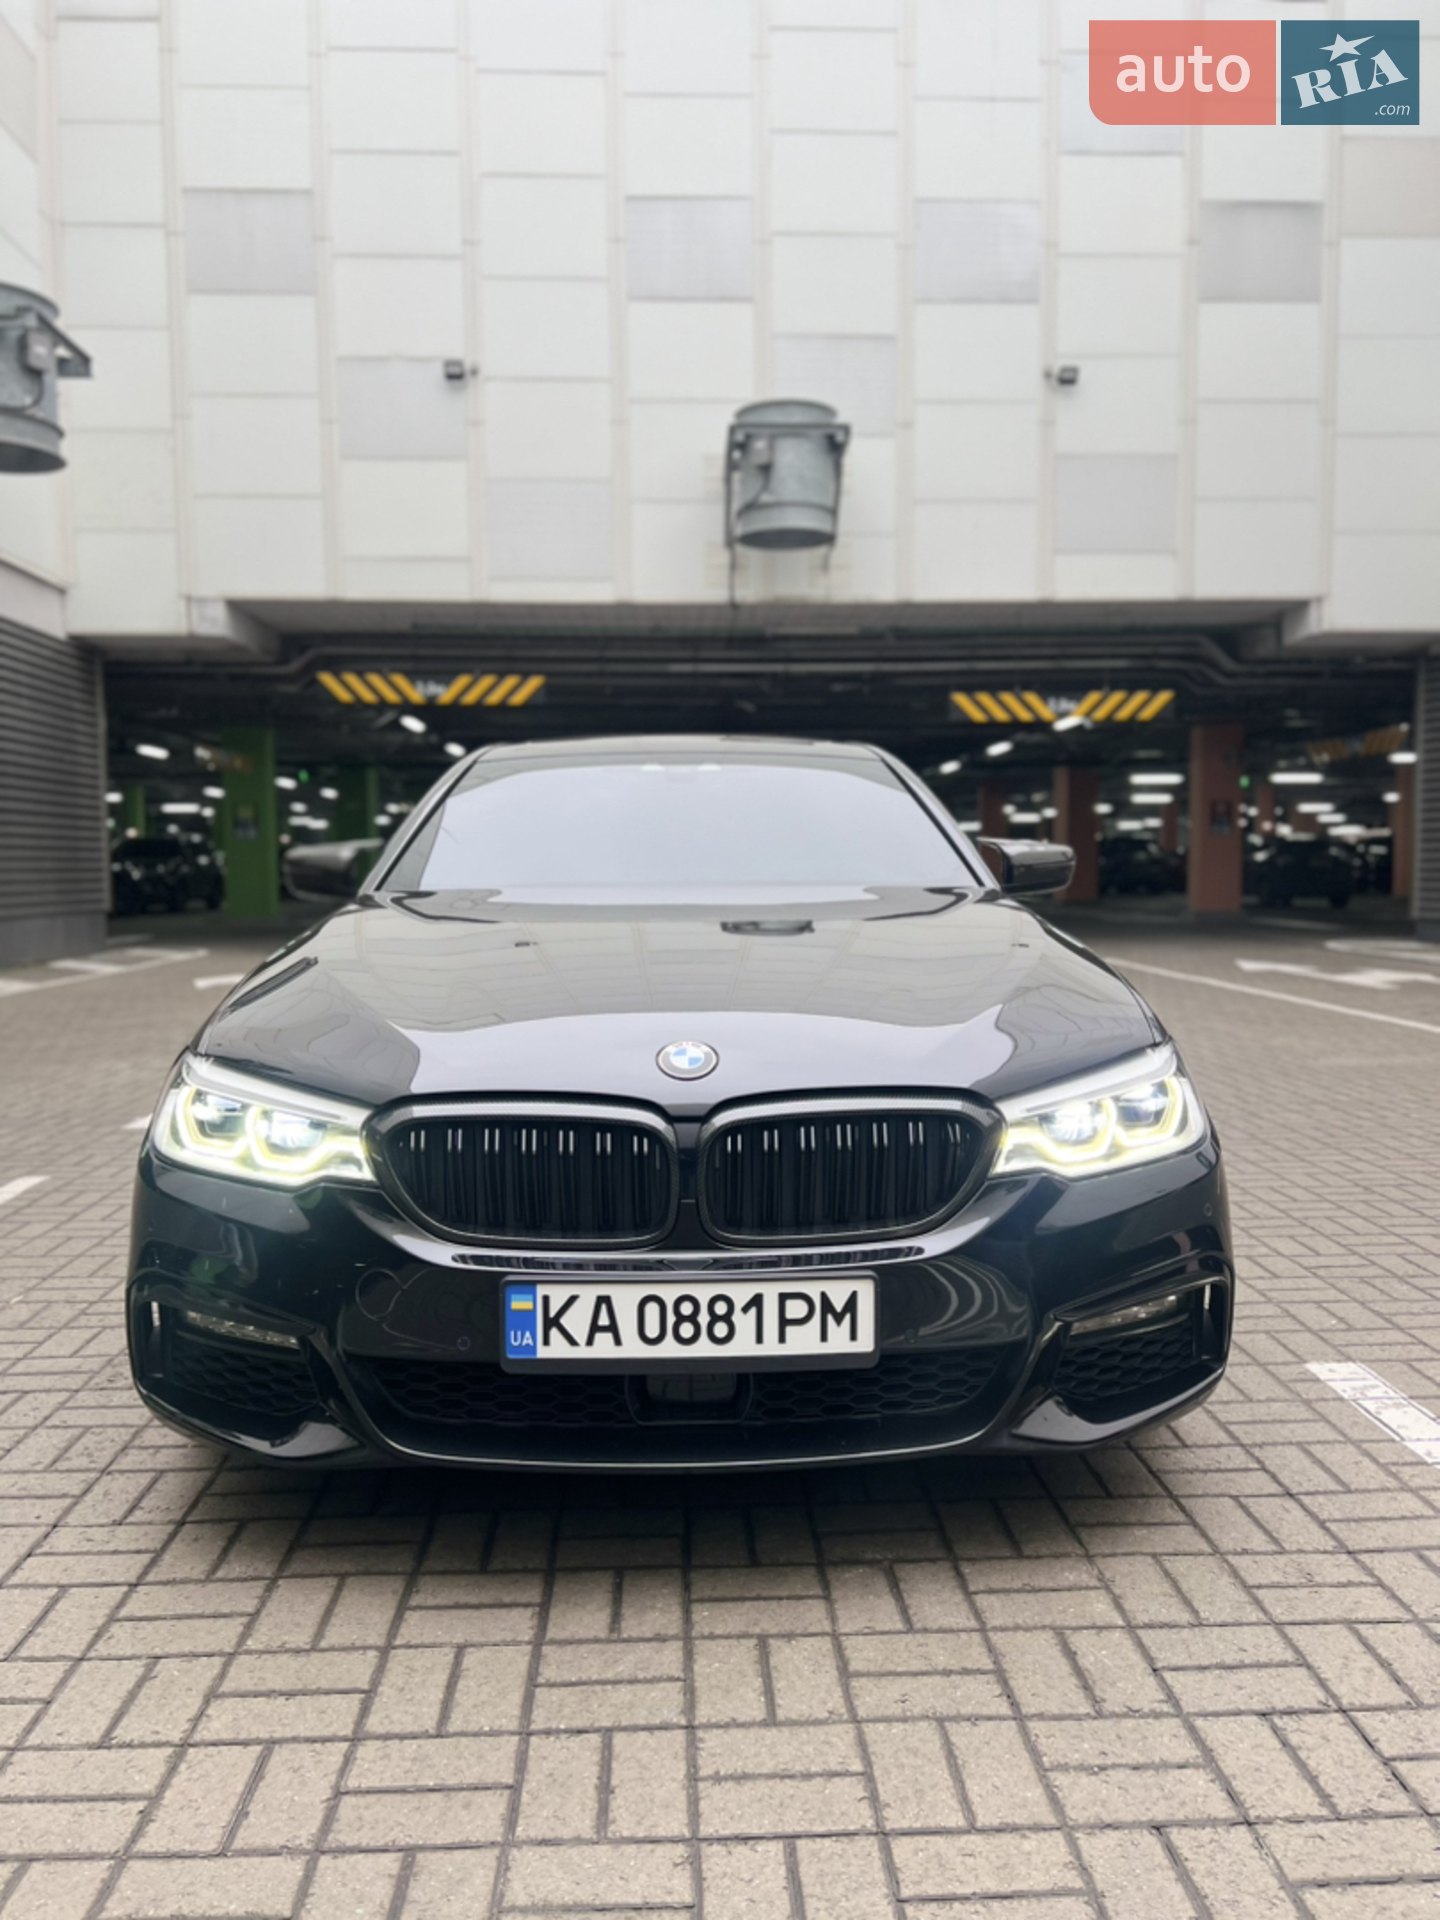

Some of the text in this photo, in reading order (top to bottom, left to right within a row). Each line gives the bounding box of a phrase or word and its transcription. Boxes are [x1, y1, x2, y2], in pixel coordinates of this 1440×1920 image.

[541, 1290, 858, 1347] KA 0881 PM
[510, 1330, 534, 1347] UA
